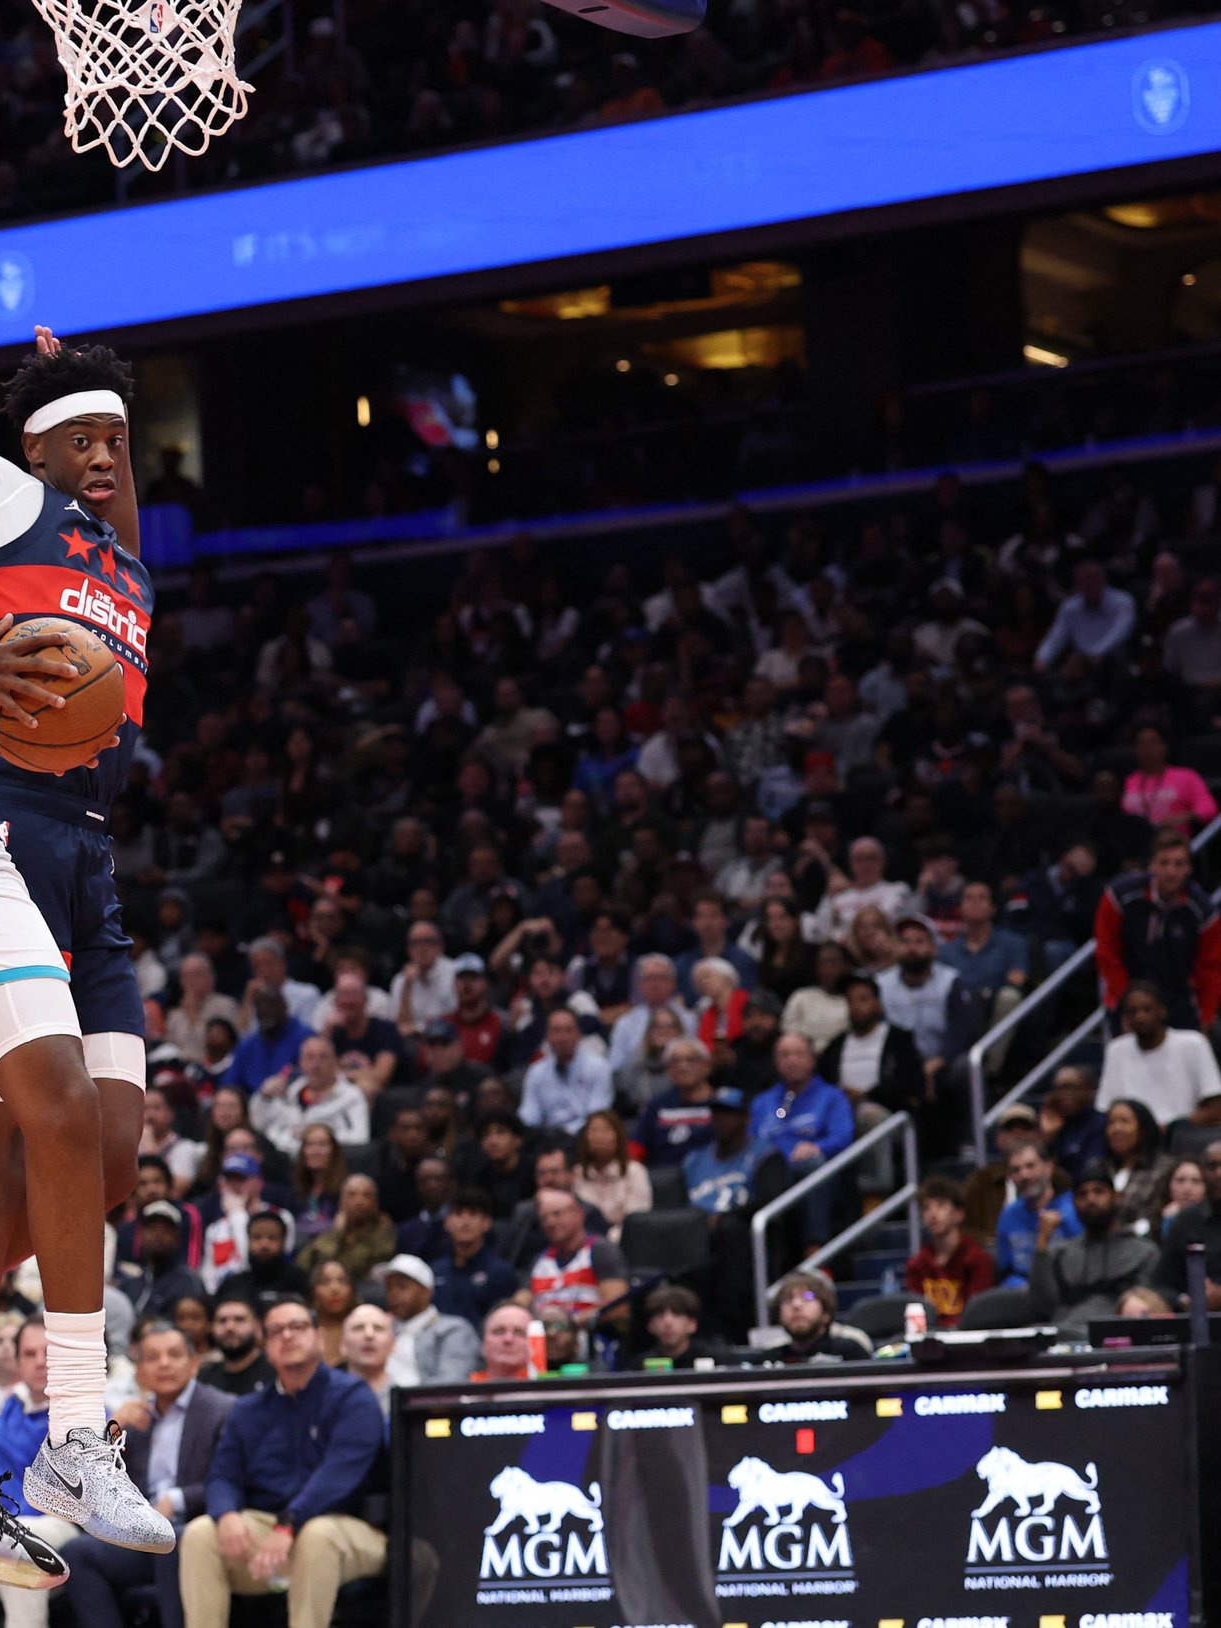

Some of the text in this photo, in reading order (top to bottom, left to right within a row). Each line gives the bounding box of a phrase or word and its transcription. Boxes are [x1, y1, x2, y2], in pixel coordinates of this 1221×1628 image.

[60, 578, 147, 657] distric
[94, 589, 111, 604] THE
[480, 1532, 608, 1578] MGM
[718, 1522, 854, 1570] MGM
[967, 1513, 1109, 1562] MGM
[964, 1576, 1041, 1590] NATIONAL
